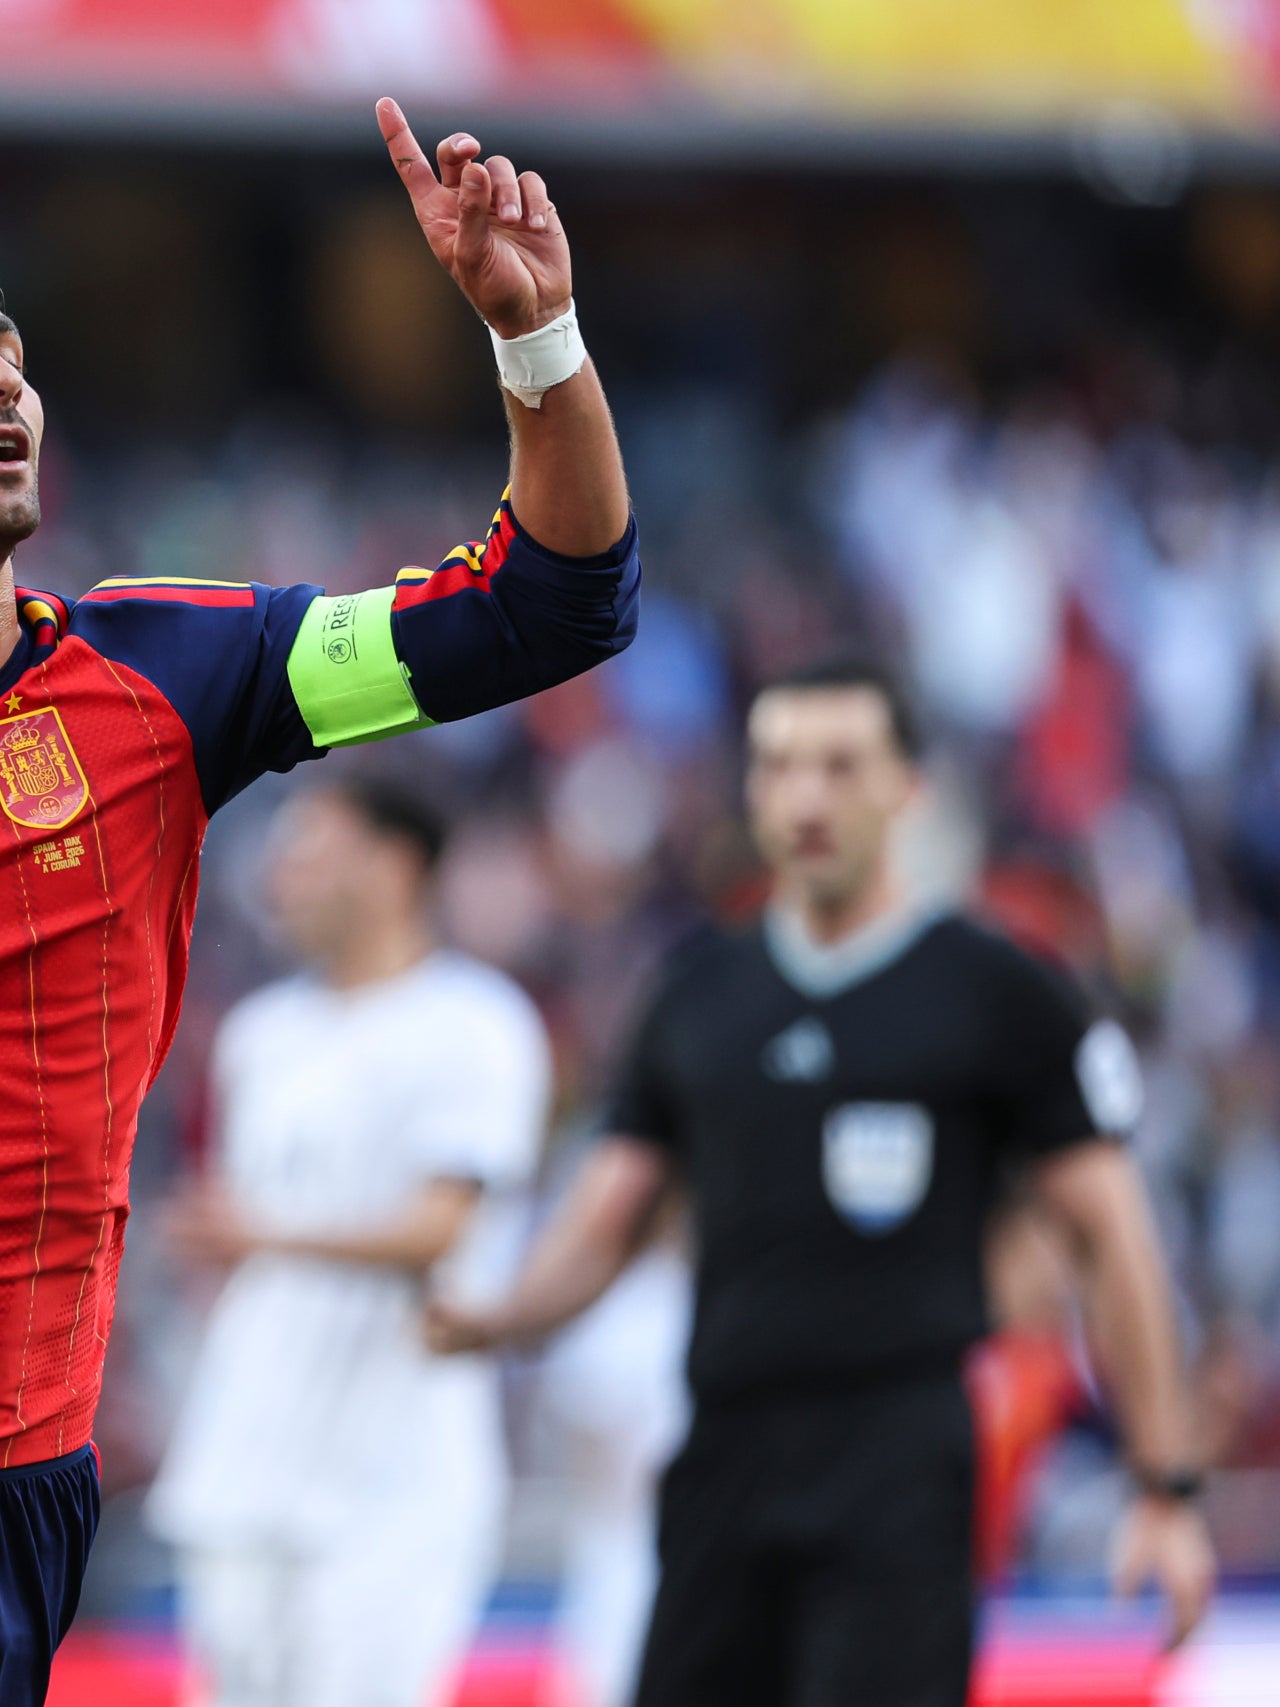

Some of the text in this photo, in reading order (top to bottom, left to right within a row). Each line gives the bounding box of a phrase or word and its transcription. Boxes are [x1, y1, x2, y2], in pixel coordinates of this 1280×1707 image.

[32, 841, 56, 855] SPAIN
[34, 845, 85, 865] 4 JUNE 2026
[42, 863, 49, 874] A
